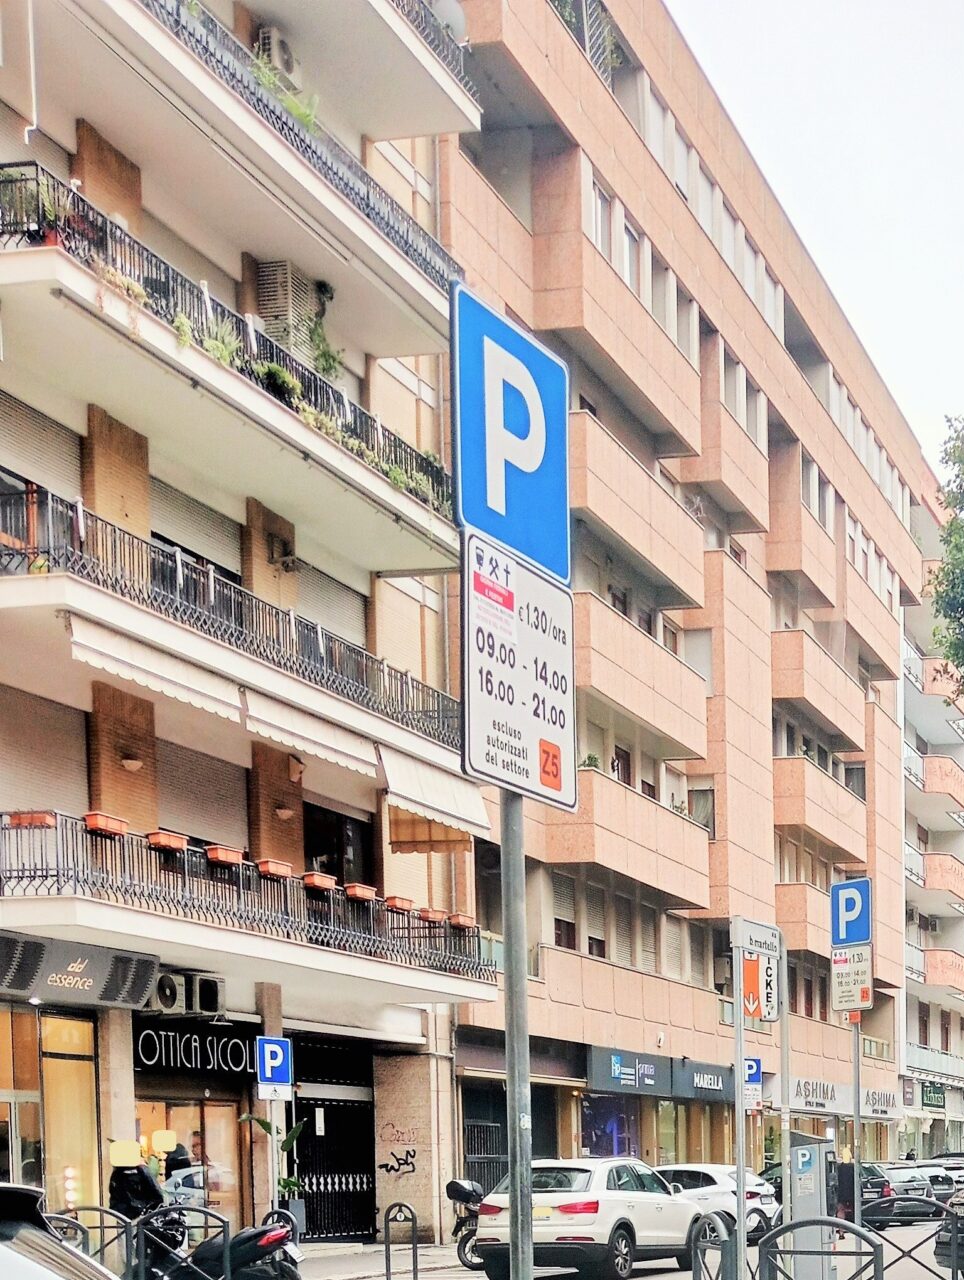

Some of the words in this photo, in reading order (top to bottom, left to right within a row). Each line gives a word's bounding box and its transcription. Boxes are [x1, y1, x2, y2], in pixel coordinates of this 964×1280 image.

[483, 334, 547, 517] P
[492, 720, 522, 741] escluso
[486, 734, 528, 760] autorizzati
[485, 749, 498, 766] del
[501, 758, 530, 779] settore
[542, 748, 559, 779] Z5
[838, 888, 862, 940] P
[47, 973, 93, 990] essence
[138, 1029, 201, 1068] OTTICA
[263, 1043, 284, 1078] P
[693, 1072, 724, 1091] MARELLA
[745, 1060, 757, 1081] P
[795, 1079, 837, 1101] ASHIMA
[865, 1089, 897, 1108] ASHIMA
[797, 1149, 811, 1170] P
